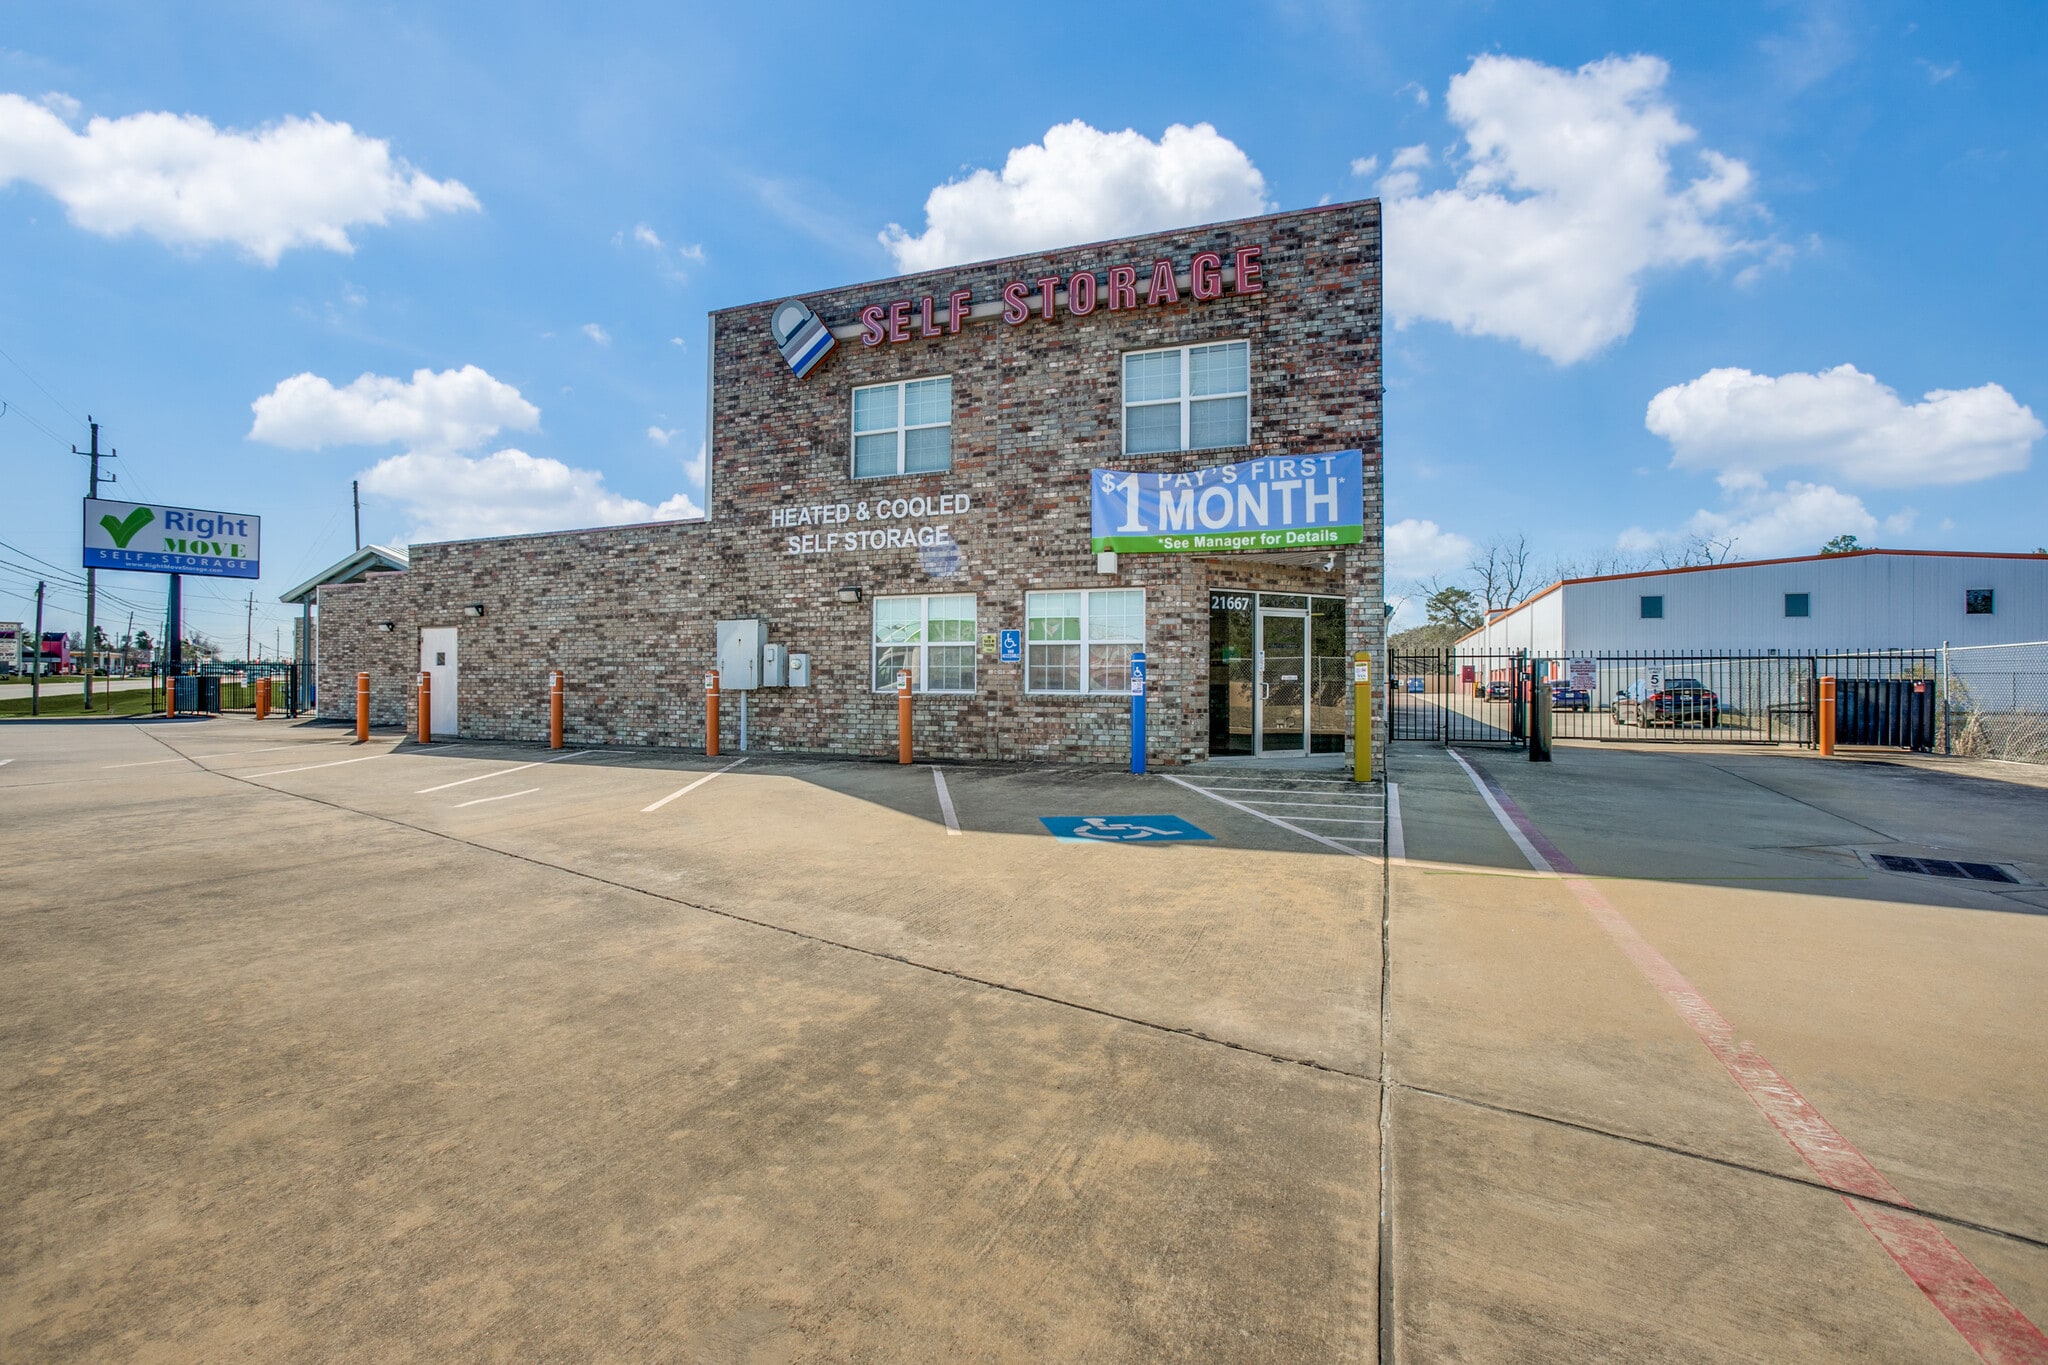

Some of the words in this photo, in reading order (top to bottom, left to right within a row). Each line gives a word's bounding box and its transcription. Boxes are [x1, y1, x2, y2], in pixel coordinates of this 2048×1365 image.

[861, 290, 972, 347] SELF
[1003, 244, 1263, 327] STORAGE
[1158, 465, 1238, 488] PAY'S
[1251, 456, 1337, 481] FIRST
[771, 503, 850, 528] HEATED
[855, 501, 871, 521] &
[876, 493, 971, 520] COOLED
[165, 510, 248, 539] Right
[163, 538, 247, 558] MOVE
[788, 532, 838, 555] SELF
[844, 525, 949, 552] STORAGE
[1193, 532, 1258, 549] Manager
[1260, 531, 1282, 546] for
[1285, 529, 1338, 545] Details
[125, 562, 223, 573] www.RightMoveStorage.com
[1211, 595, 1250, 611] 21667
[1651, 674, 1659, 684] 5
